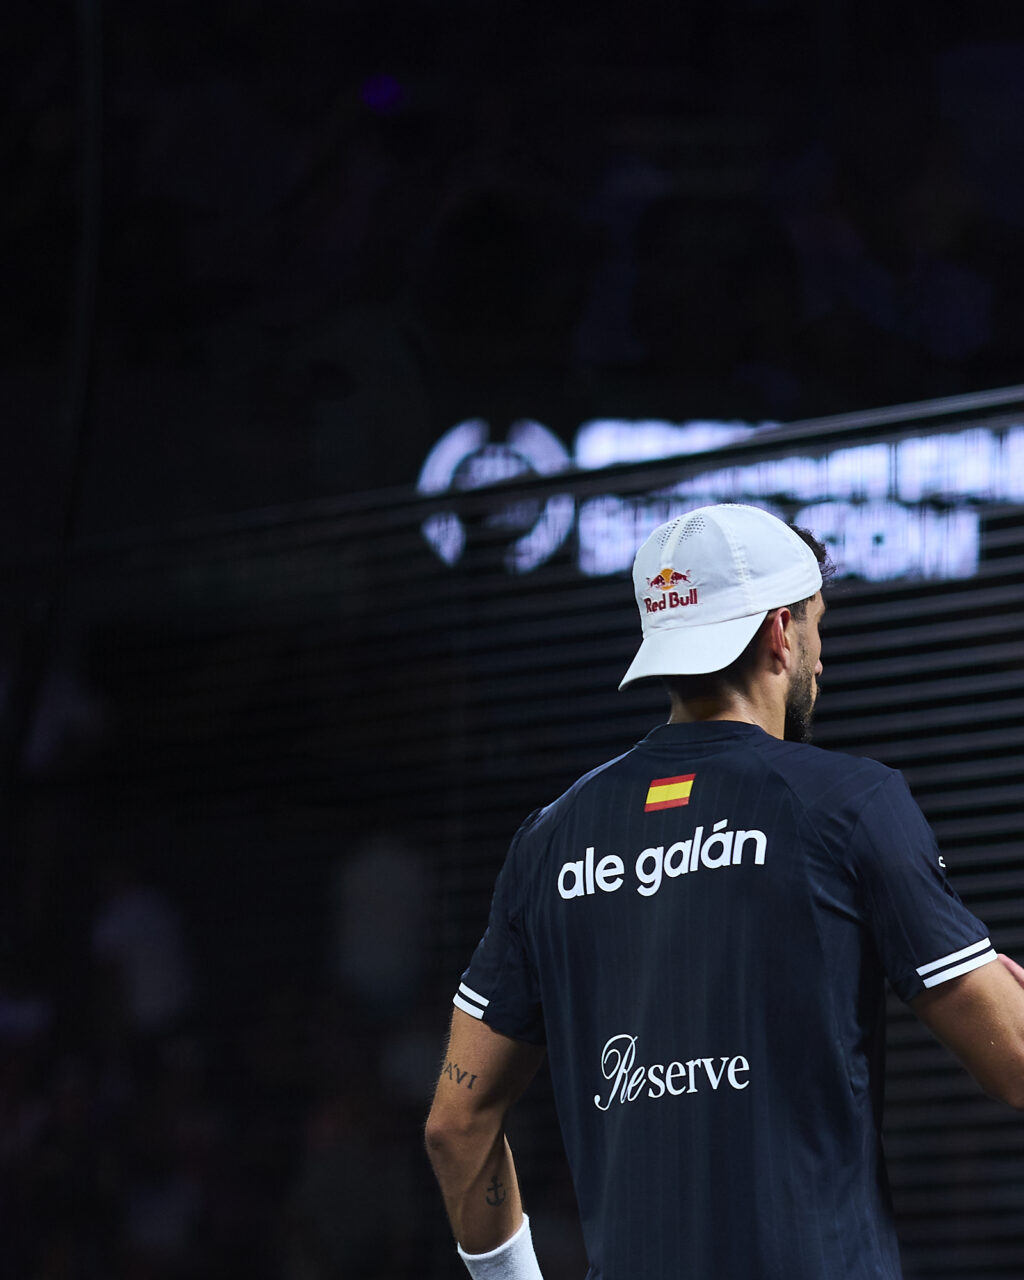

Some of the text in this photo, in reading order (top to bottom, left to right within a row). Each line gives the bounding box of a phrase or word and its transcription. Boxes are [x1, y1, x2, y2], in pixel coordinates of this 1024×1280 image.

[643, 588, 698, 614] Red Bull
[557, 818, 768, 899] ale galán
[594, 1033, 750, 1111] Reserve
